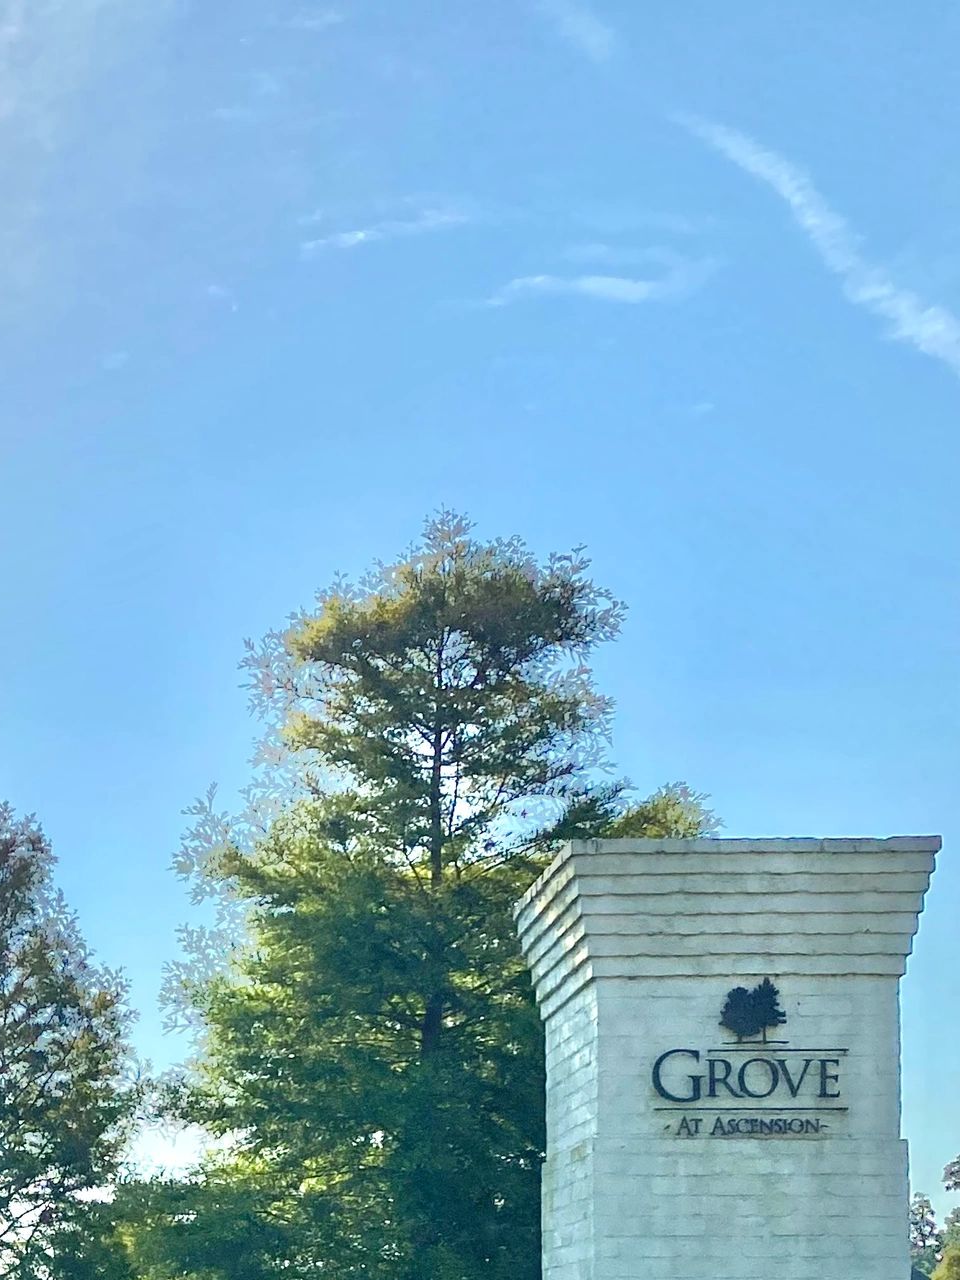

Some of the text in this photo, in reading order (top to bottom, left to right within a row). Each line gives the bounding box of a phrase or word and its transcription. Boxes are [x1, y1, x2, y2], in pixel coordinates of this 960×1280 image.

[651, 1048, 841, 1103] GROVE
[675, 1115, 821, 1137] AT ASCENSION
